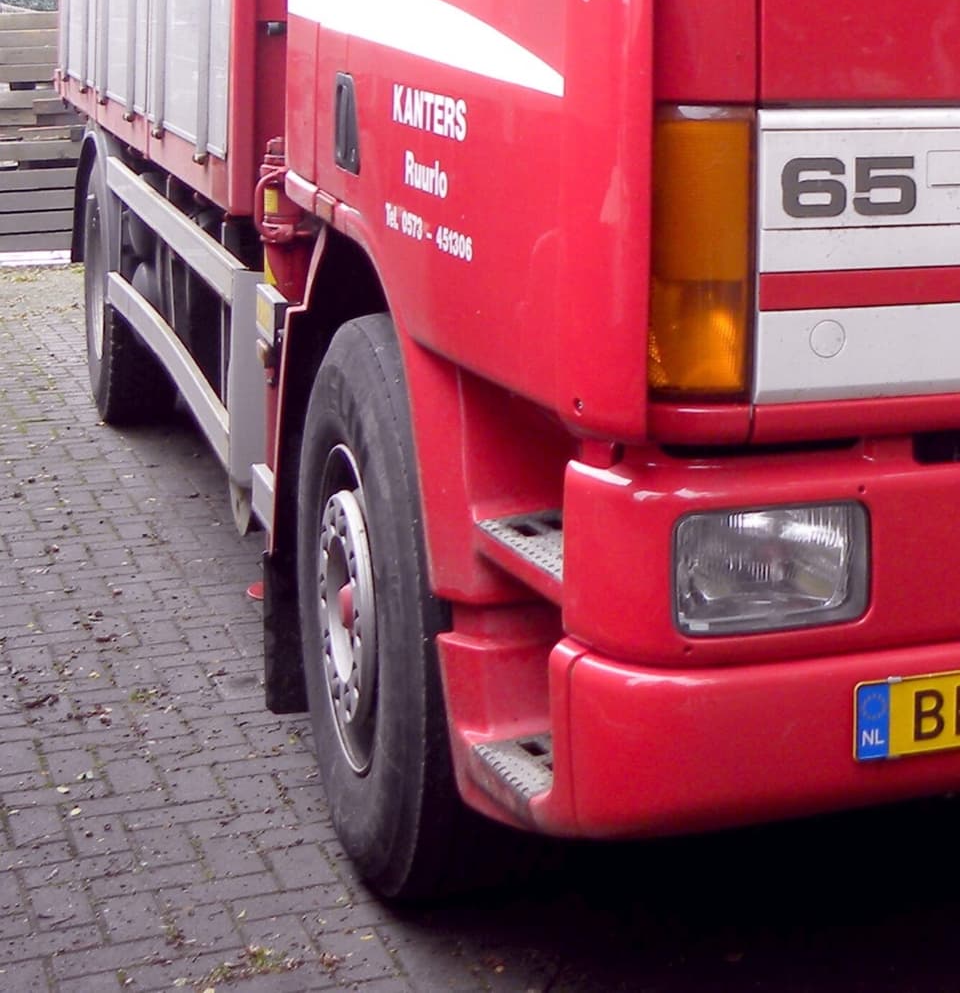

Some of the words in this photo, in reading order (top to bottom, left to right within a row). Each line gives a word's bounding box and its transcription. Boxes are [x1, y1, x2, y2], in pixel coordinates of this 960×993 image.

[393, 84, 468, 141] KANTERS
[404, 151, 448, 199] Ruurlo
[781, 156, 917, 219] 65
[401, 210, 423, 241] 0573
[435, 225, 473, 262] 451306
[861, 730, 885, 746] NL
